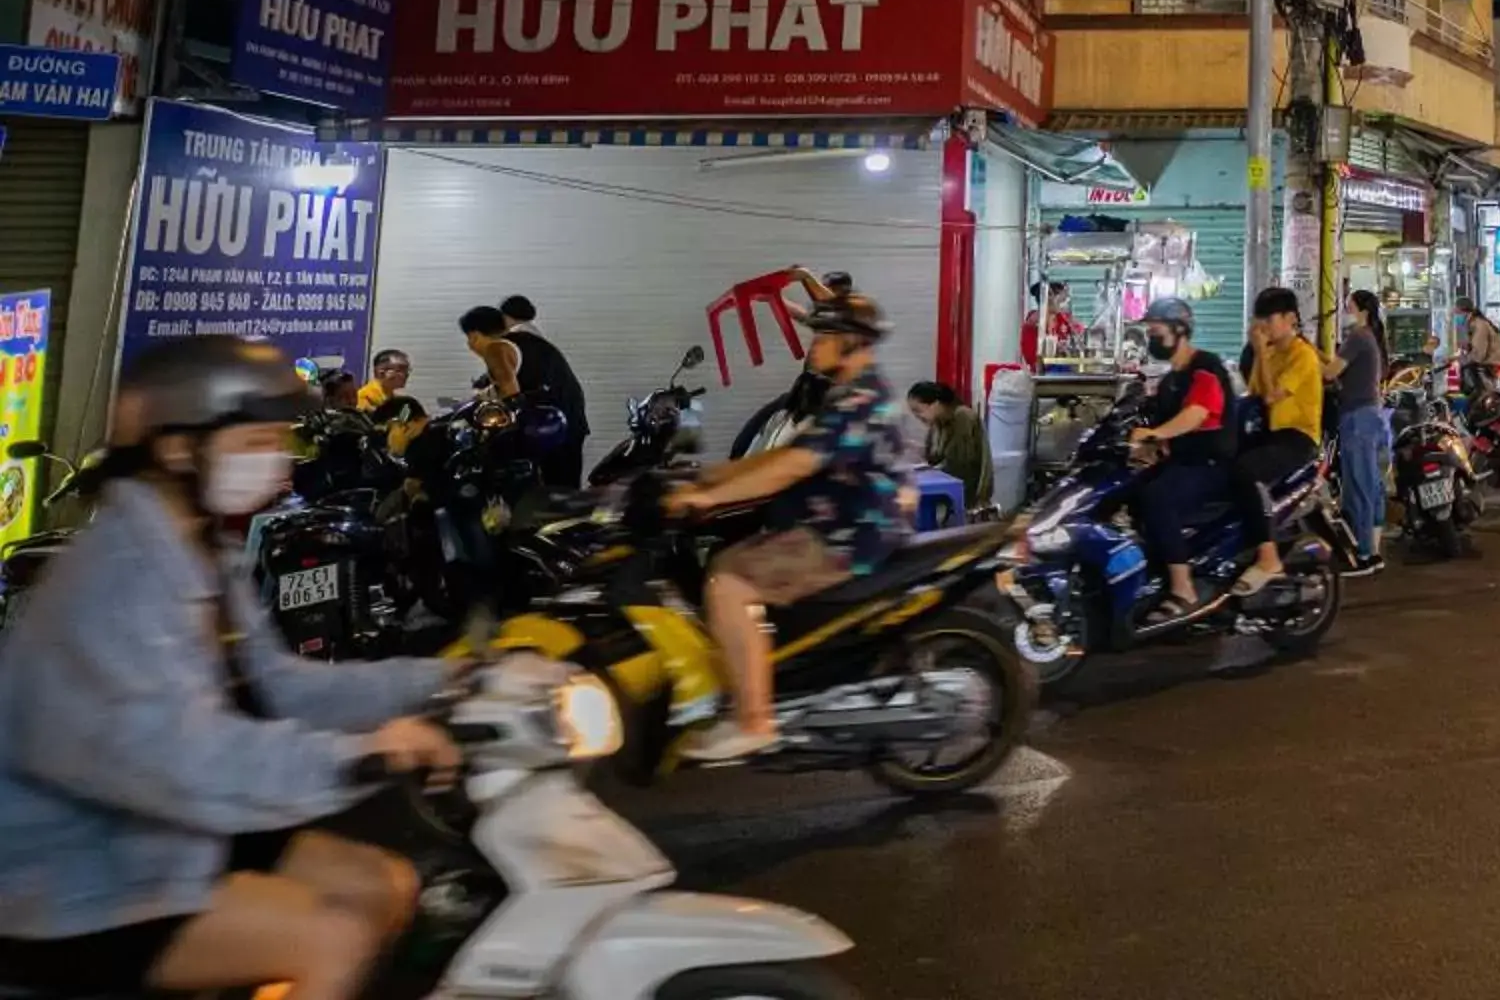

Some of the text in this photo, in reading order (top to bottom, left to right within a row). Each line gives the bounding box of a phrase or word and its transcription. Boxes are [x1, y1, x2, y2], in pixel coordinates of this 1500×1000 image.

[7, 53, 86, 77] ĐƯỜNG
[75, 86, 111, 108] HAI
[183, 129, 245, 163] TRUNG
[248, 137, 286, 168] TÂM
[143, 166, 374, 263] HỮU PHÁT
[163, 291, 198, 312] 0908
[200, 291, 225, 312] 945
[147, 319, 194, 337] Email:
